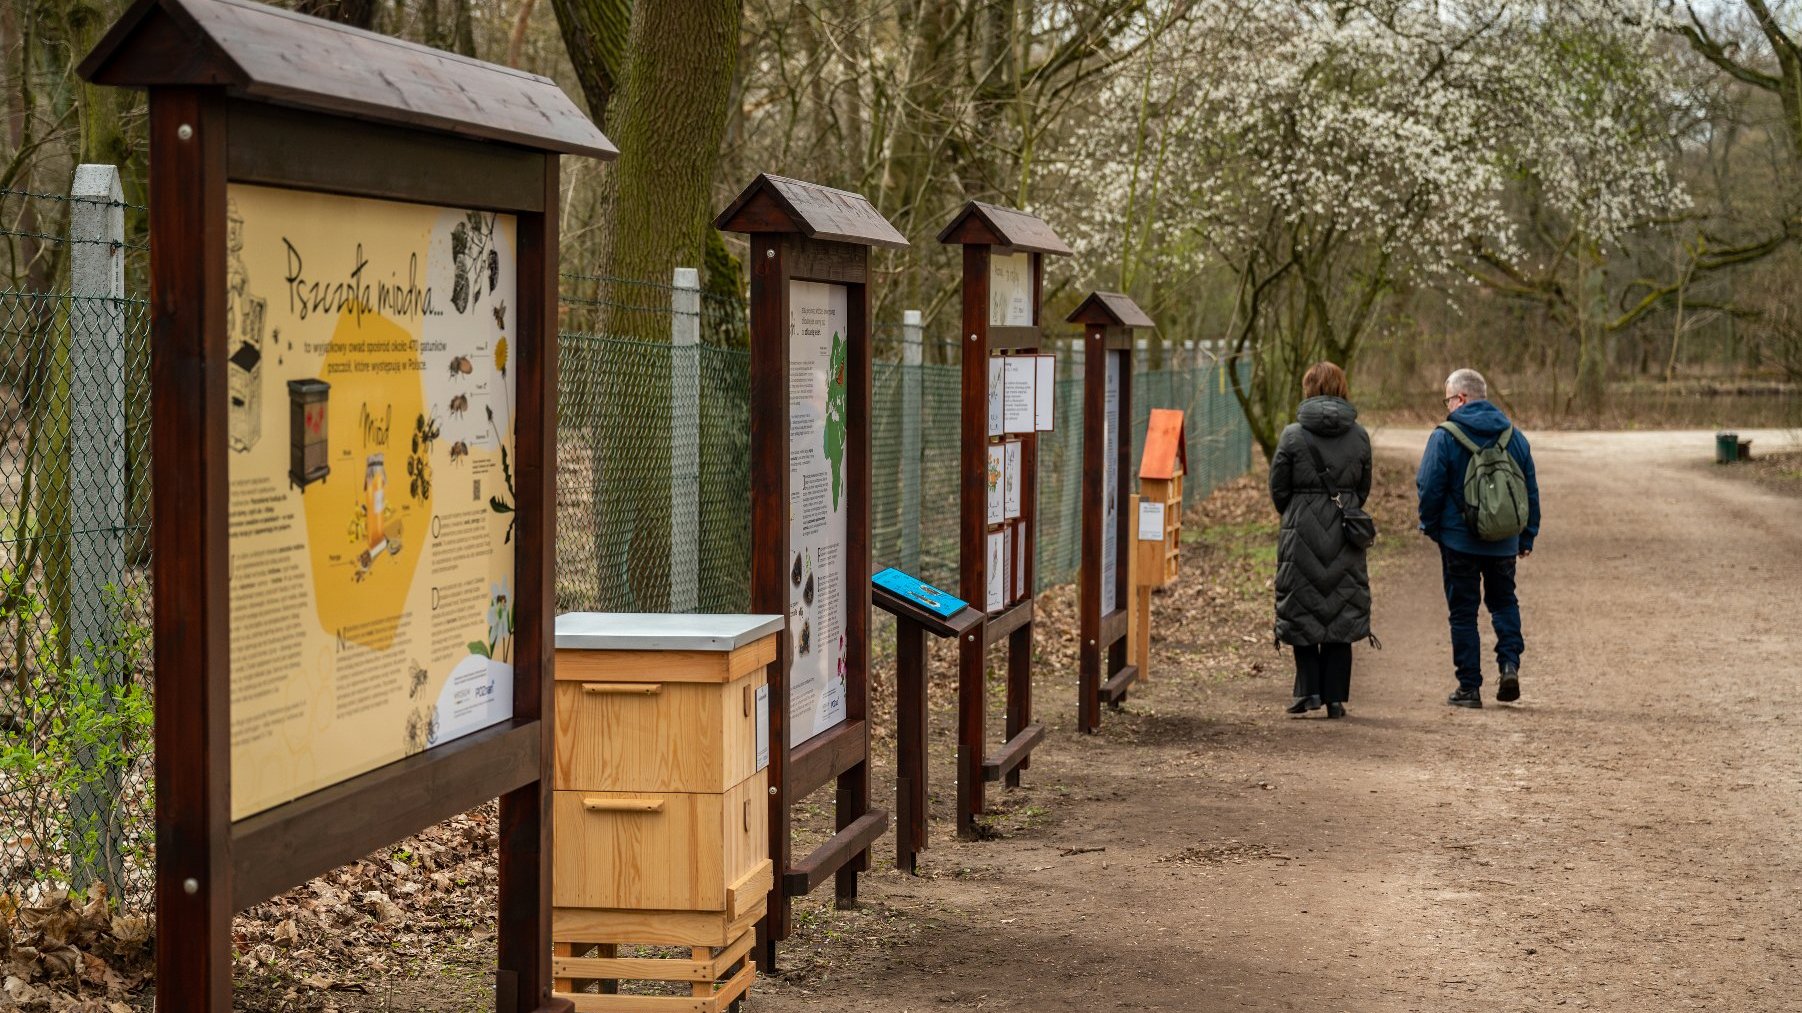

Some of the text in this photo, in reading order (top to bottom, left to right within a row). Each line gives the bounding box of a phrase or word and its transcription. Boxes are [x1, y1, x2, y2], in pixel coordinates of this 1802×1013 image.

[282, 236, 443, 330] Pszczoła miodna...
[359, 402, 393, 448] Miód
